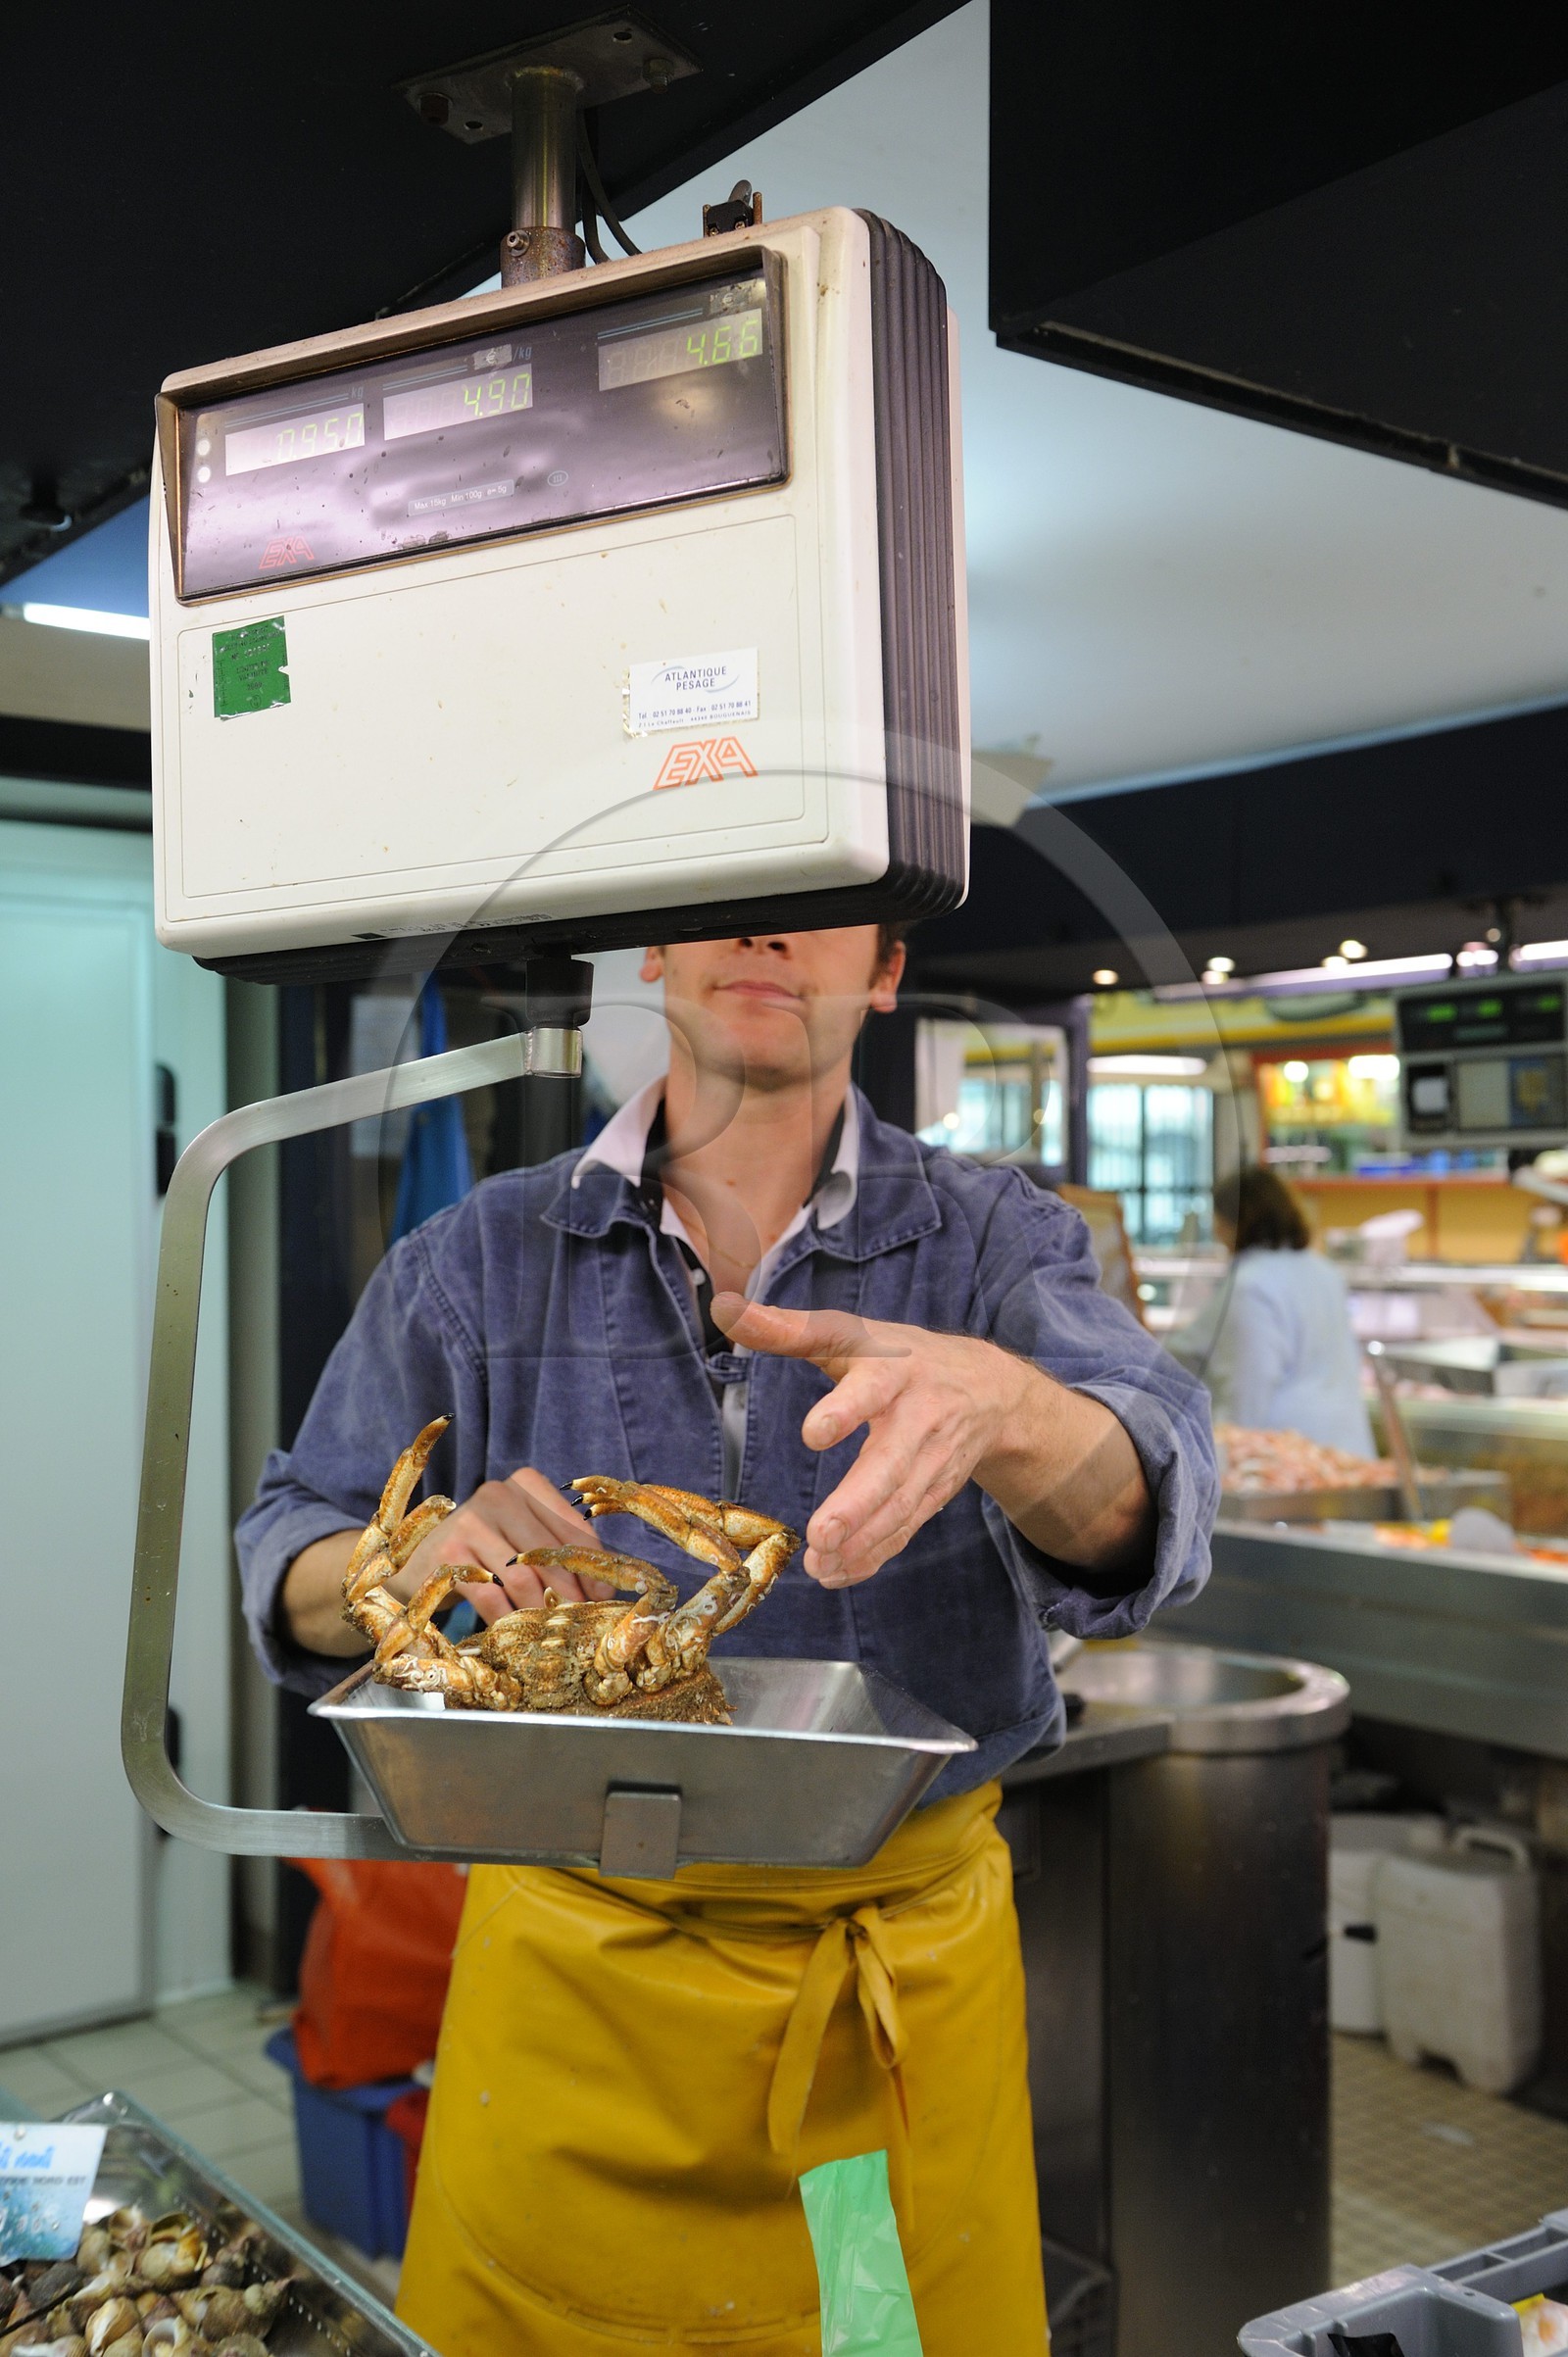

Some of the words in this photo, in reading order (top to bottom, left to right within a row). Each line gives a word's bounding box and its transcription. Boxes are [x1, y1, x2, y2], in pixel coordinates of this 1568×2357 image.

[687, 319, 760, 366] 4.66
[350, 385, 364, 400] kg
[464, 371, 531, 417] 4.90
[414, 502, 428, 511] Max
[429, 499, 447, 508] 15kg
[451, 493, 464, 503] Min
[465, 490, 482, 501] 100g
[259, 535, 315, 569] EXA
[664, 665, 727, 682] ATLANTIQUE
[676, 678, 715, 691] PESAGE
[653, 736, 759, 791] EXA
